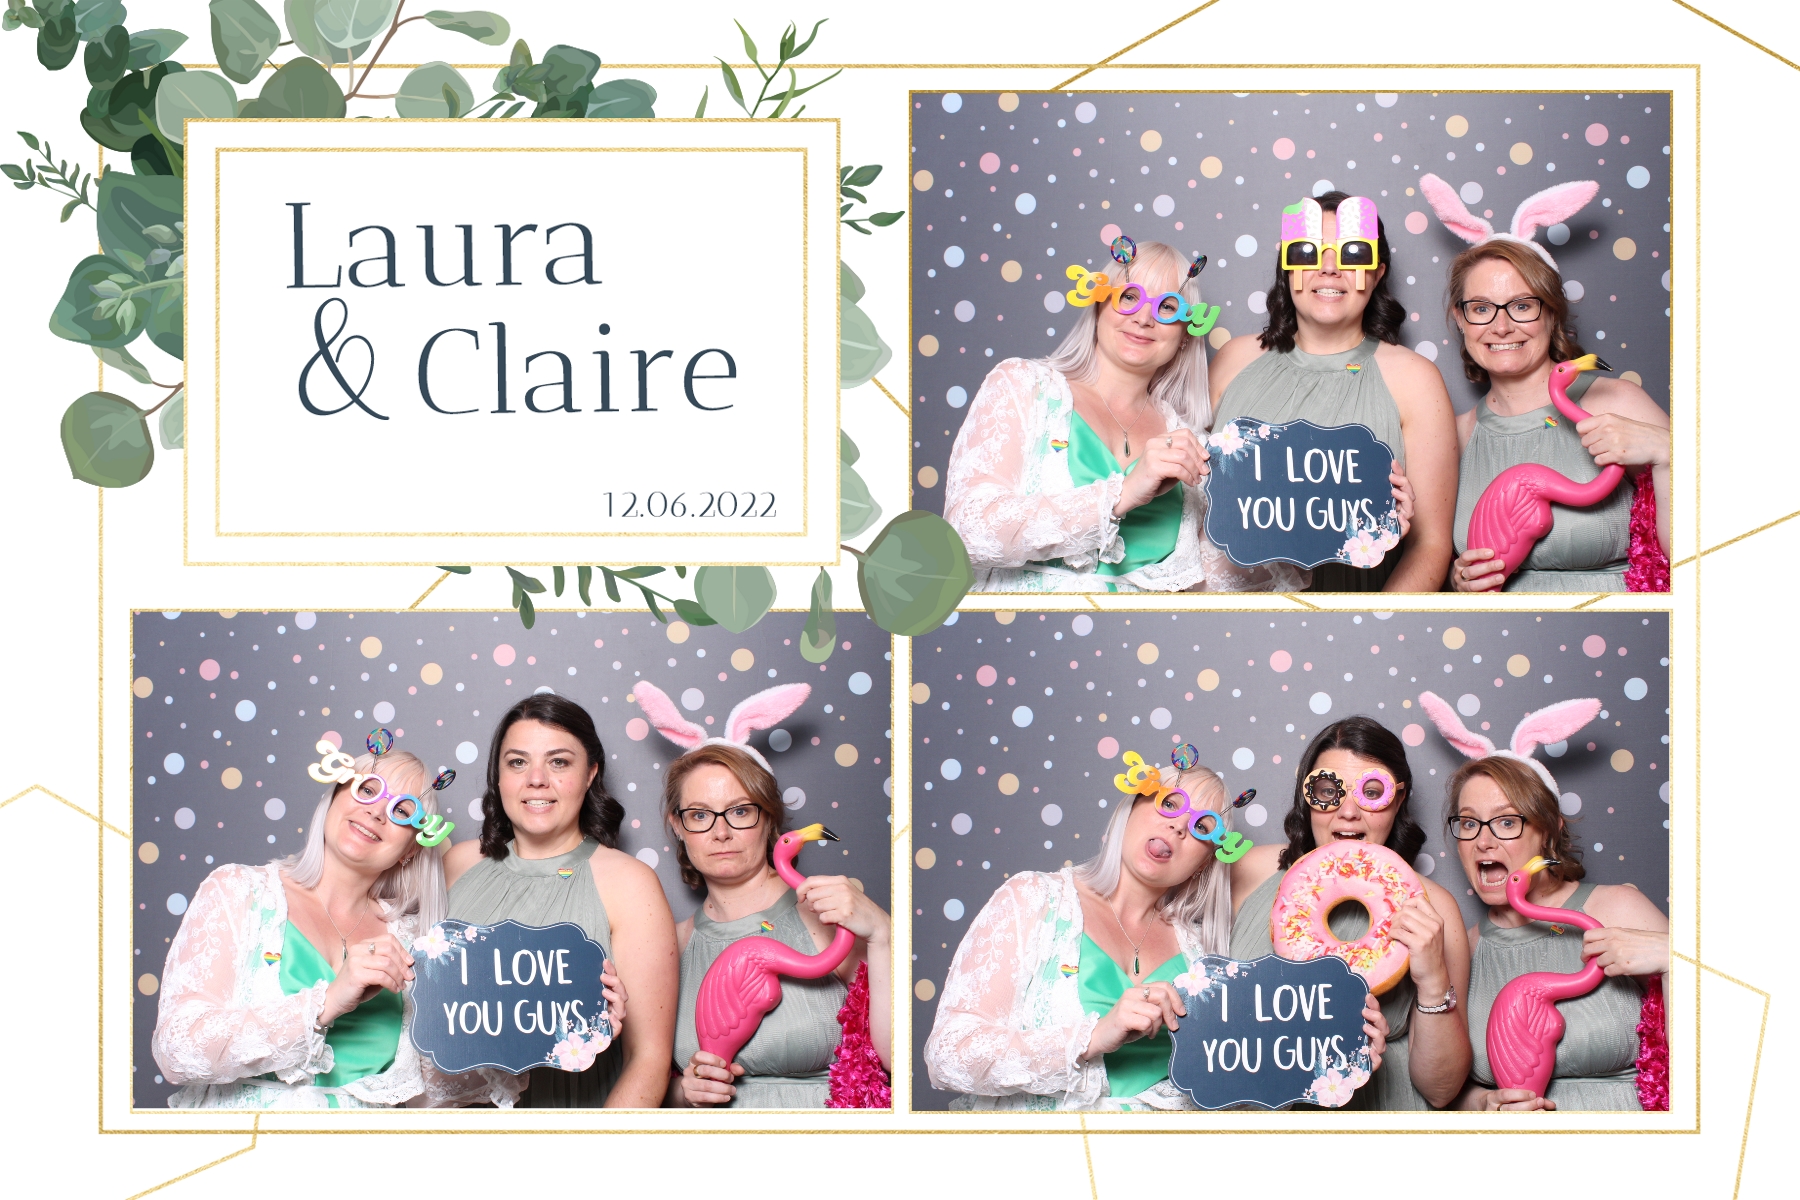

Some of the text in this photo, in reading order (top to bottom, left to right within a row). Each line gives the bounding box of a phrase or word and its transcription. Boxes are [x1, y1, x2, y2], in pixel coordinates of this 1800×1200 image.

[1254, 444, 1362, 484] I LOVE
[1237, 496, 1378, 533] YOU GUYS
[460, 947, 573, 986] I LOVE
[443, 999, 588, 1036] YOU GUYS
[1221, 983, 1334, 1022] I LOVE
[1202, 1034, 1348, 1073] YOU GUYS
